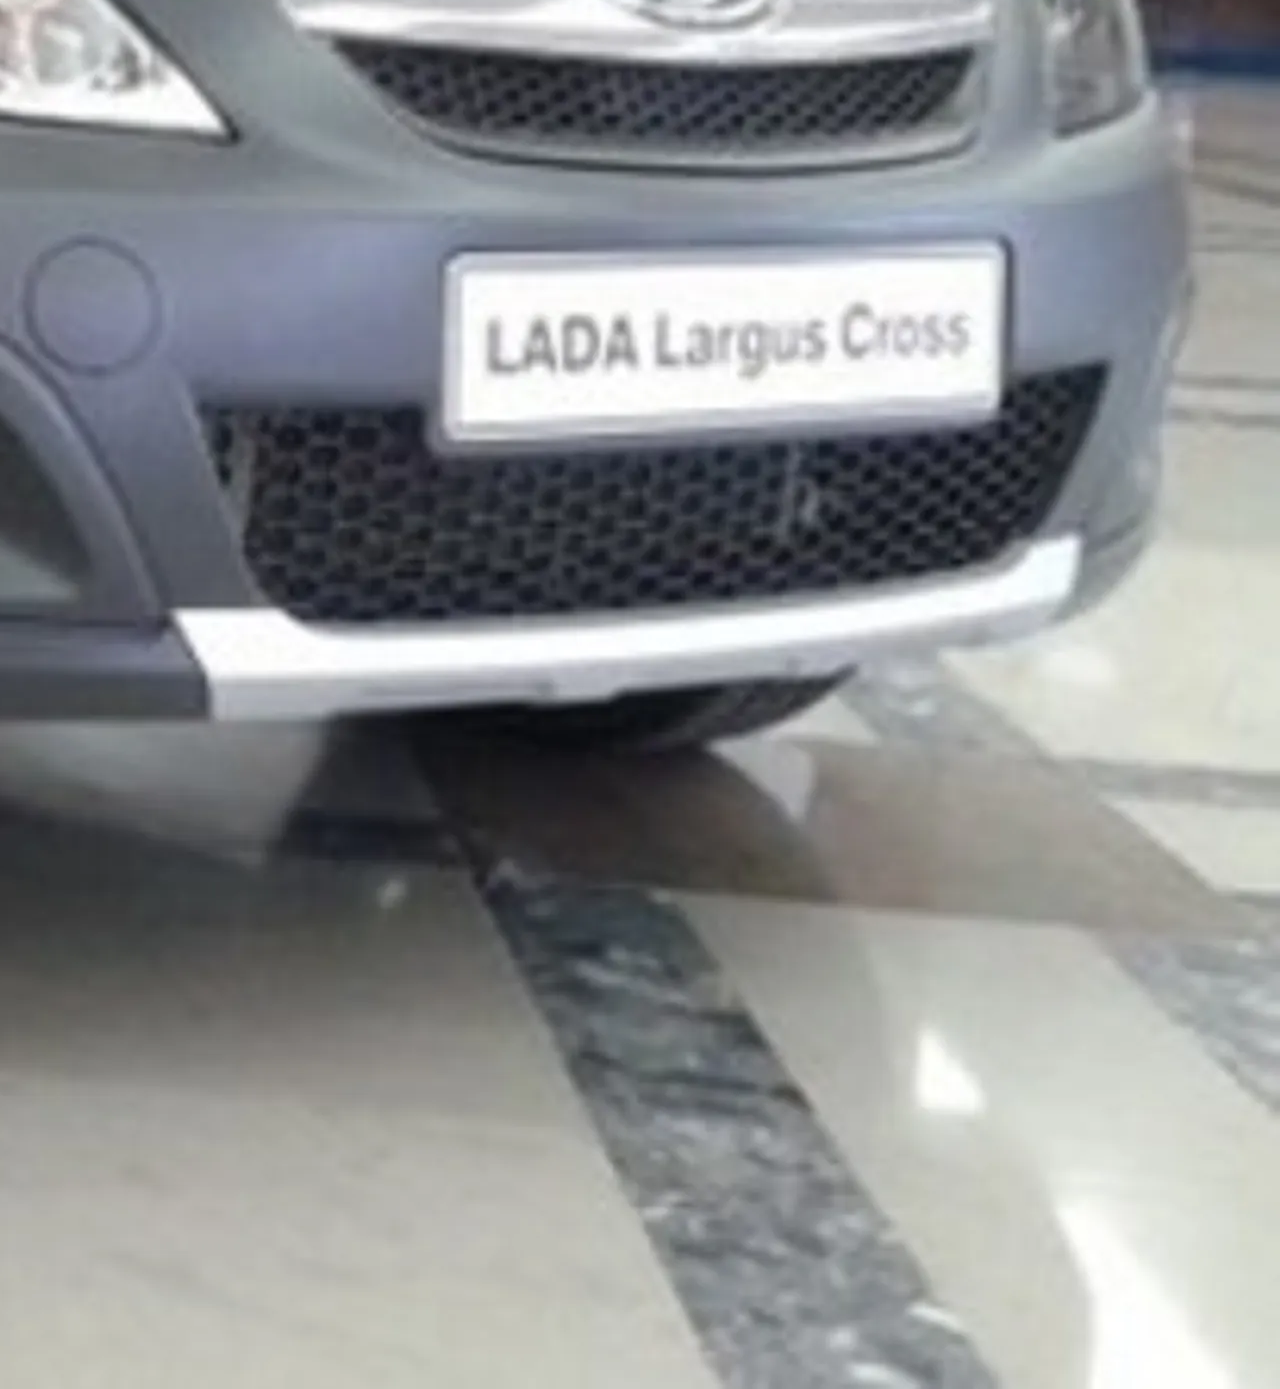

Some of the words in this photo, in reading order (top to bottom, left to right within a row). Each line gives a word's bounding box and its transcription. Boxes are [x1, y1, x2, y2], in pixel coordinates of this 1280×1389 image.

[485, 314, 639, 375] LADA
[654, 309, 829, 379] Largus
[841, 302, 971, 358] Cross
